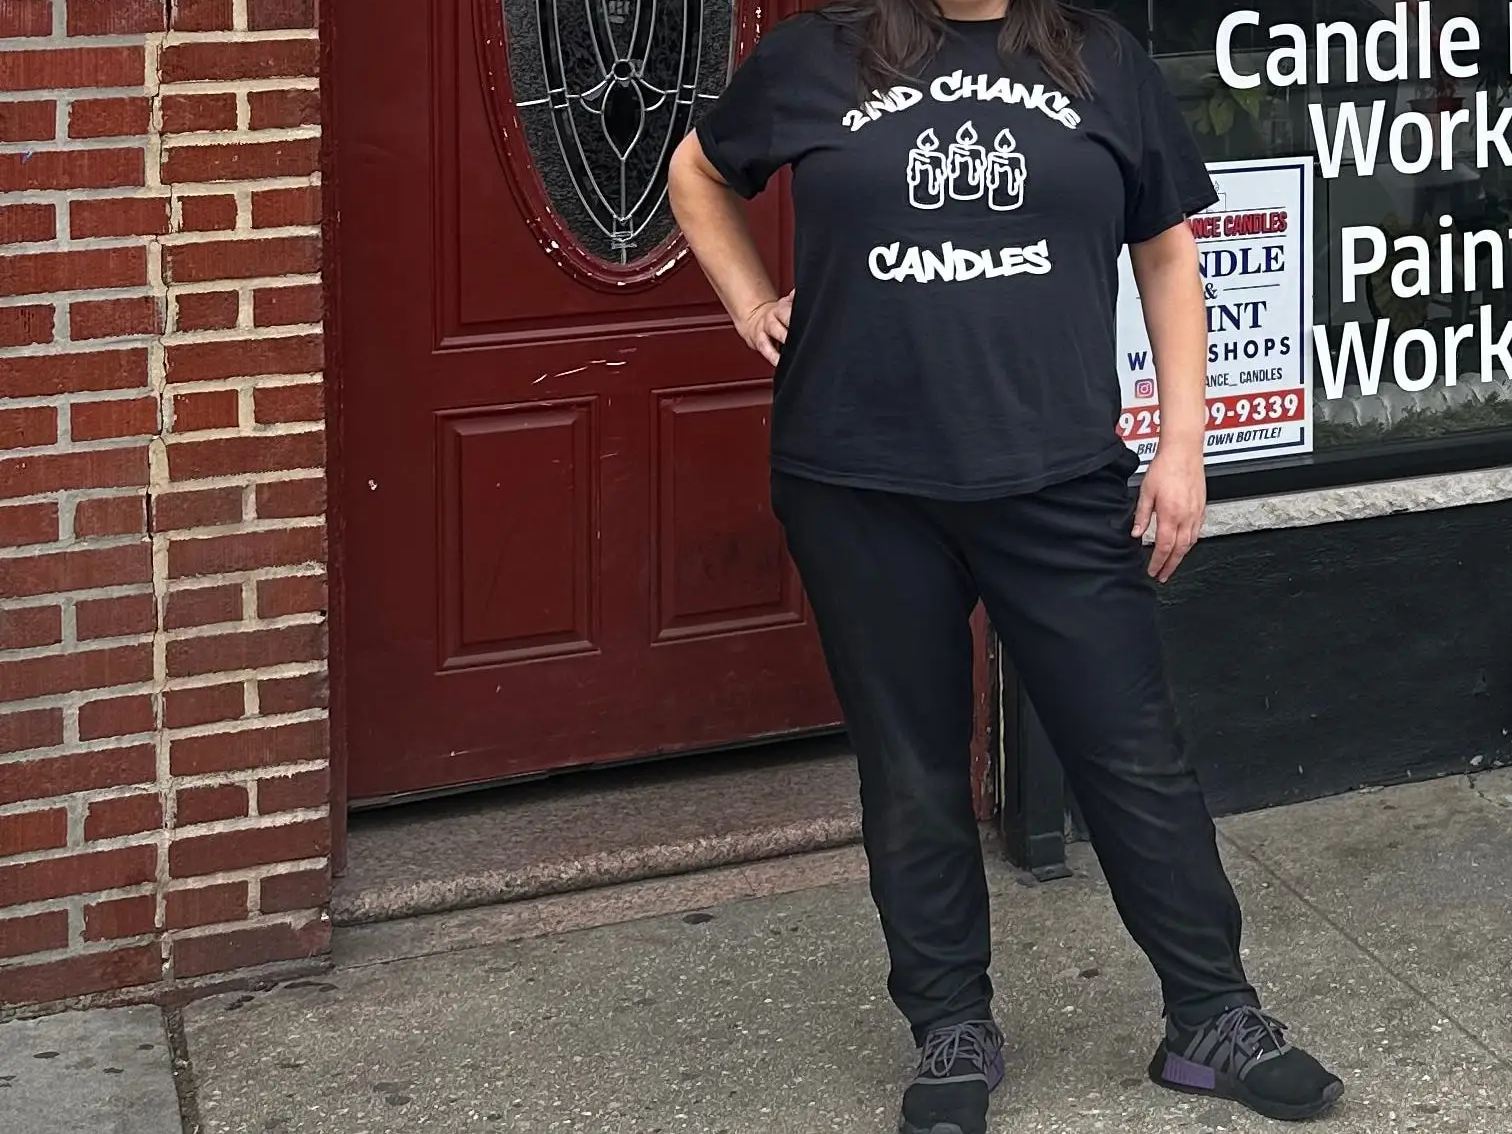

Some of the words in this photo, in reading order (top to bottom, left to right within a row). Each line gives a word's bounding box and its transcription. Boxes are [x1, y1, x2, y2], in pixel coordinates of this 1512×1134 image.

[1215, 0, 1481, 89] Candle
[842, 85, 924, 132] 2ND
[930, 69, 1082, 130] CHANCE
[1224, 211, 1287, 237] CANDLES
[868, 239, 1051, 283] CANDLES
[1199, 245, 1285, 278] NDLE
[1203, 282, 1218, 300] &
[1206, 300, 1267, 333] INT
[1128, 337, 1291, 371] WSHOPS
[1240, 367, 1283, 384] CANDLES
[1207, 433, 1234, 446] OWN
[1236, 427, 1282, 443] BOTTLE!
